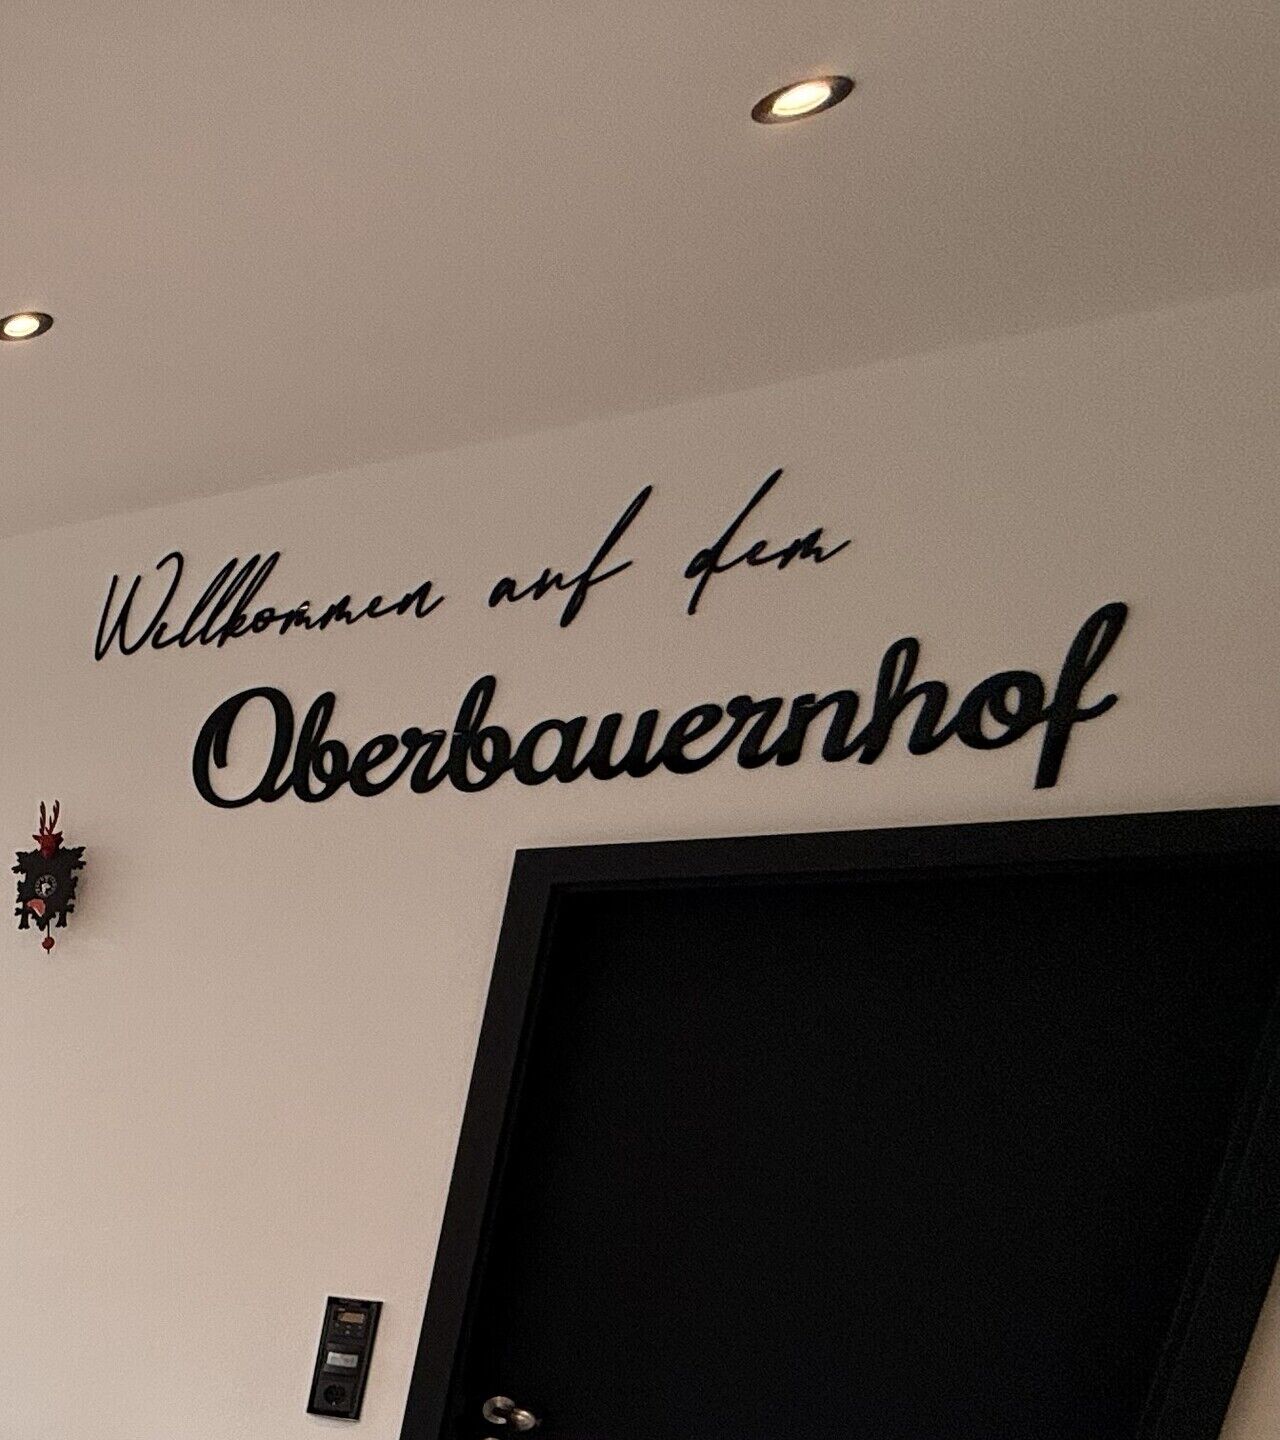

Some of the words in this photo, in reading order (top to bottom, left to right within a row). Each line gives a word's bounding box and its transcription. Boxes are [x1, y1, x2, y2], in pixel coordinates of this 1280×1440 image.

[94, 551, 446, 662] Willkommen
[488, 484, 654, 628] auf
[684, 468, 852, 616] dem
[192, 601, 1130, 809] Oberbauernhof
